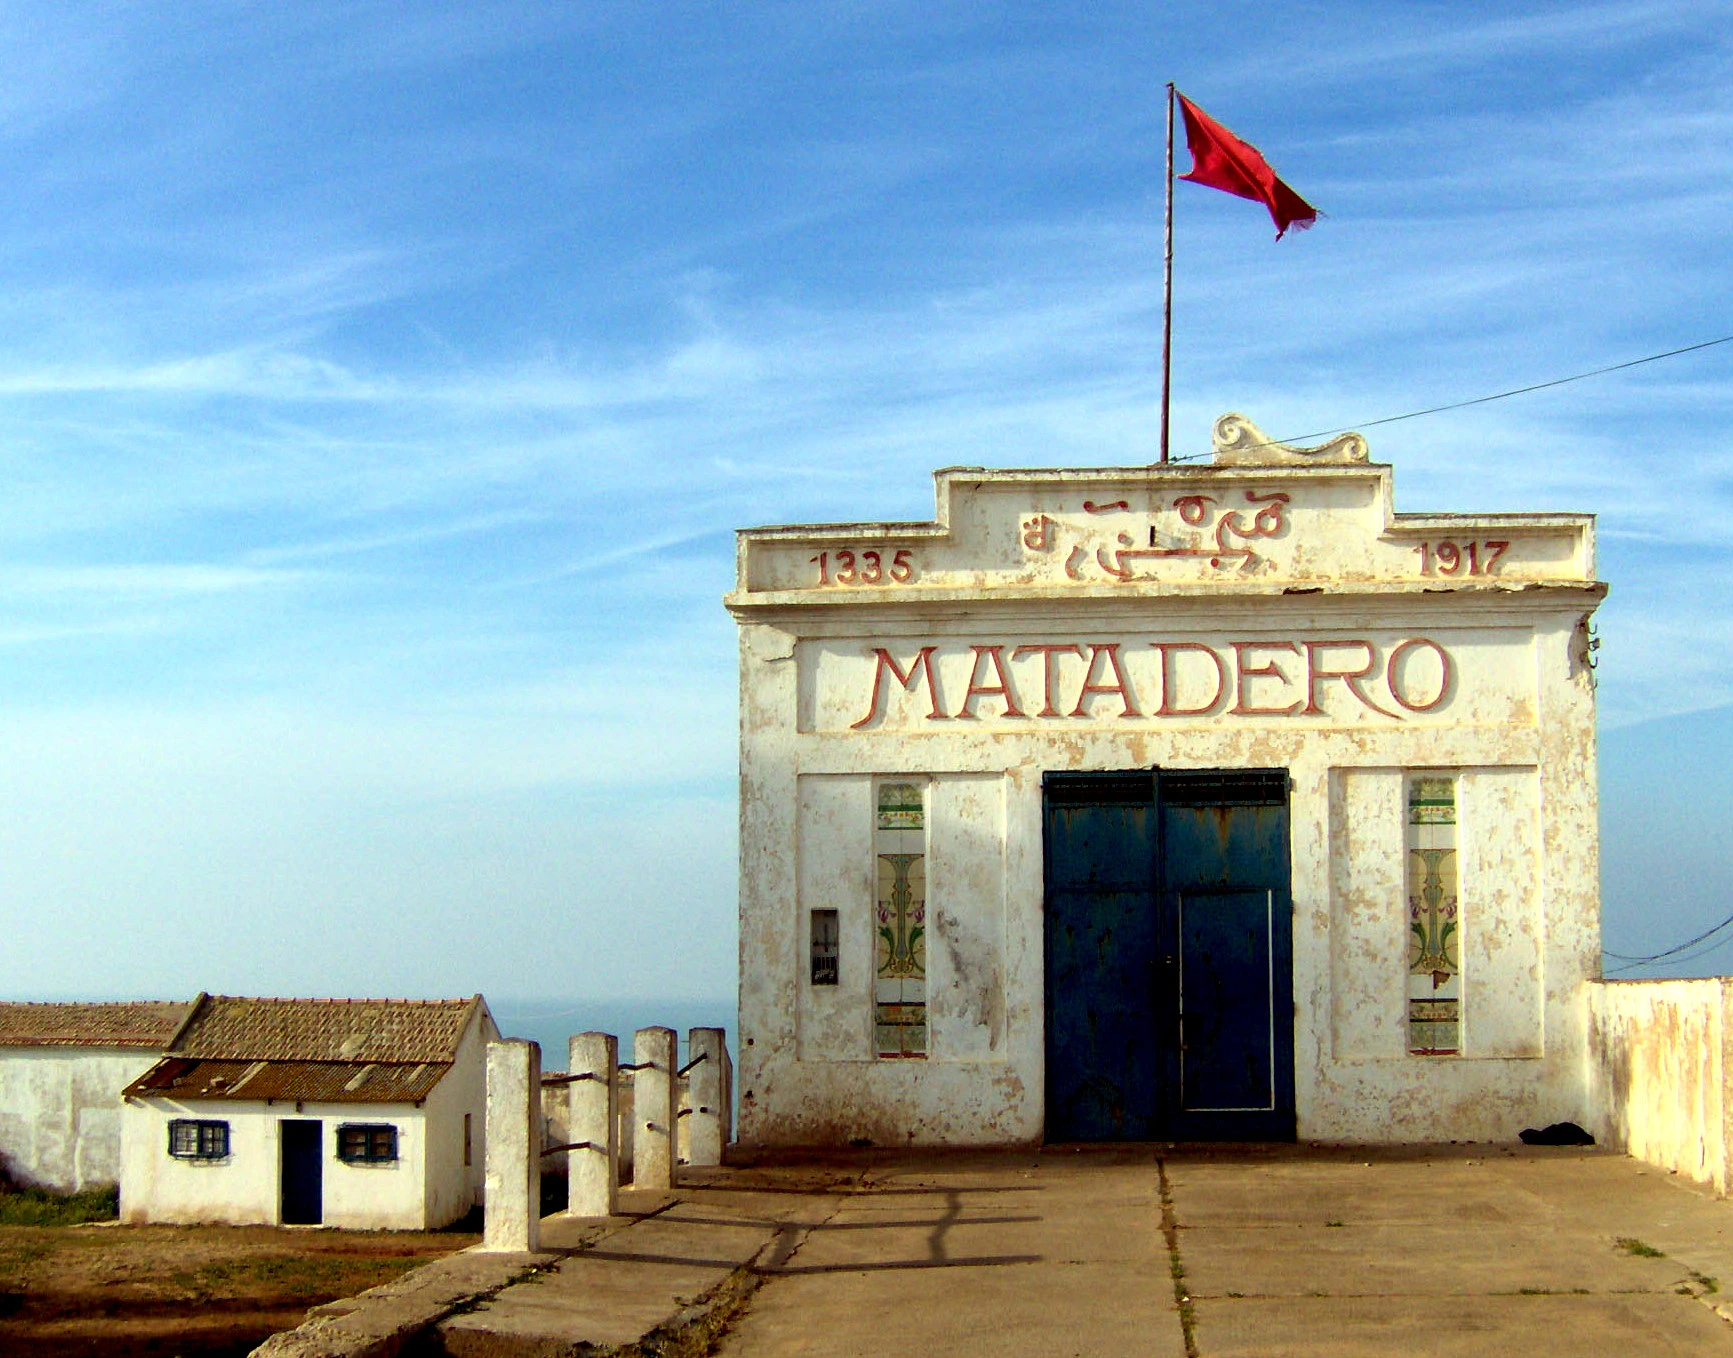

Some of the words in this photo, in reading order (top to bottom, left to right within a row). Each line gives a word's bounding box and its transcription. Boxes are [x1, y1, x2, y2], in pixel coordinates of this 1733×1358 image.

[810, 550, 913, 585] 1335
[1412, 541, 1510, 576] 1917
[849, 637, 1450, 729] MATADERO
